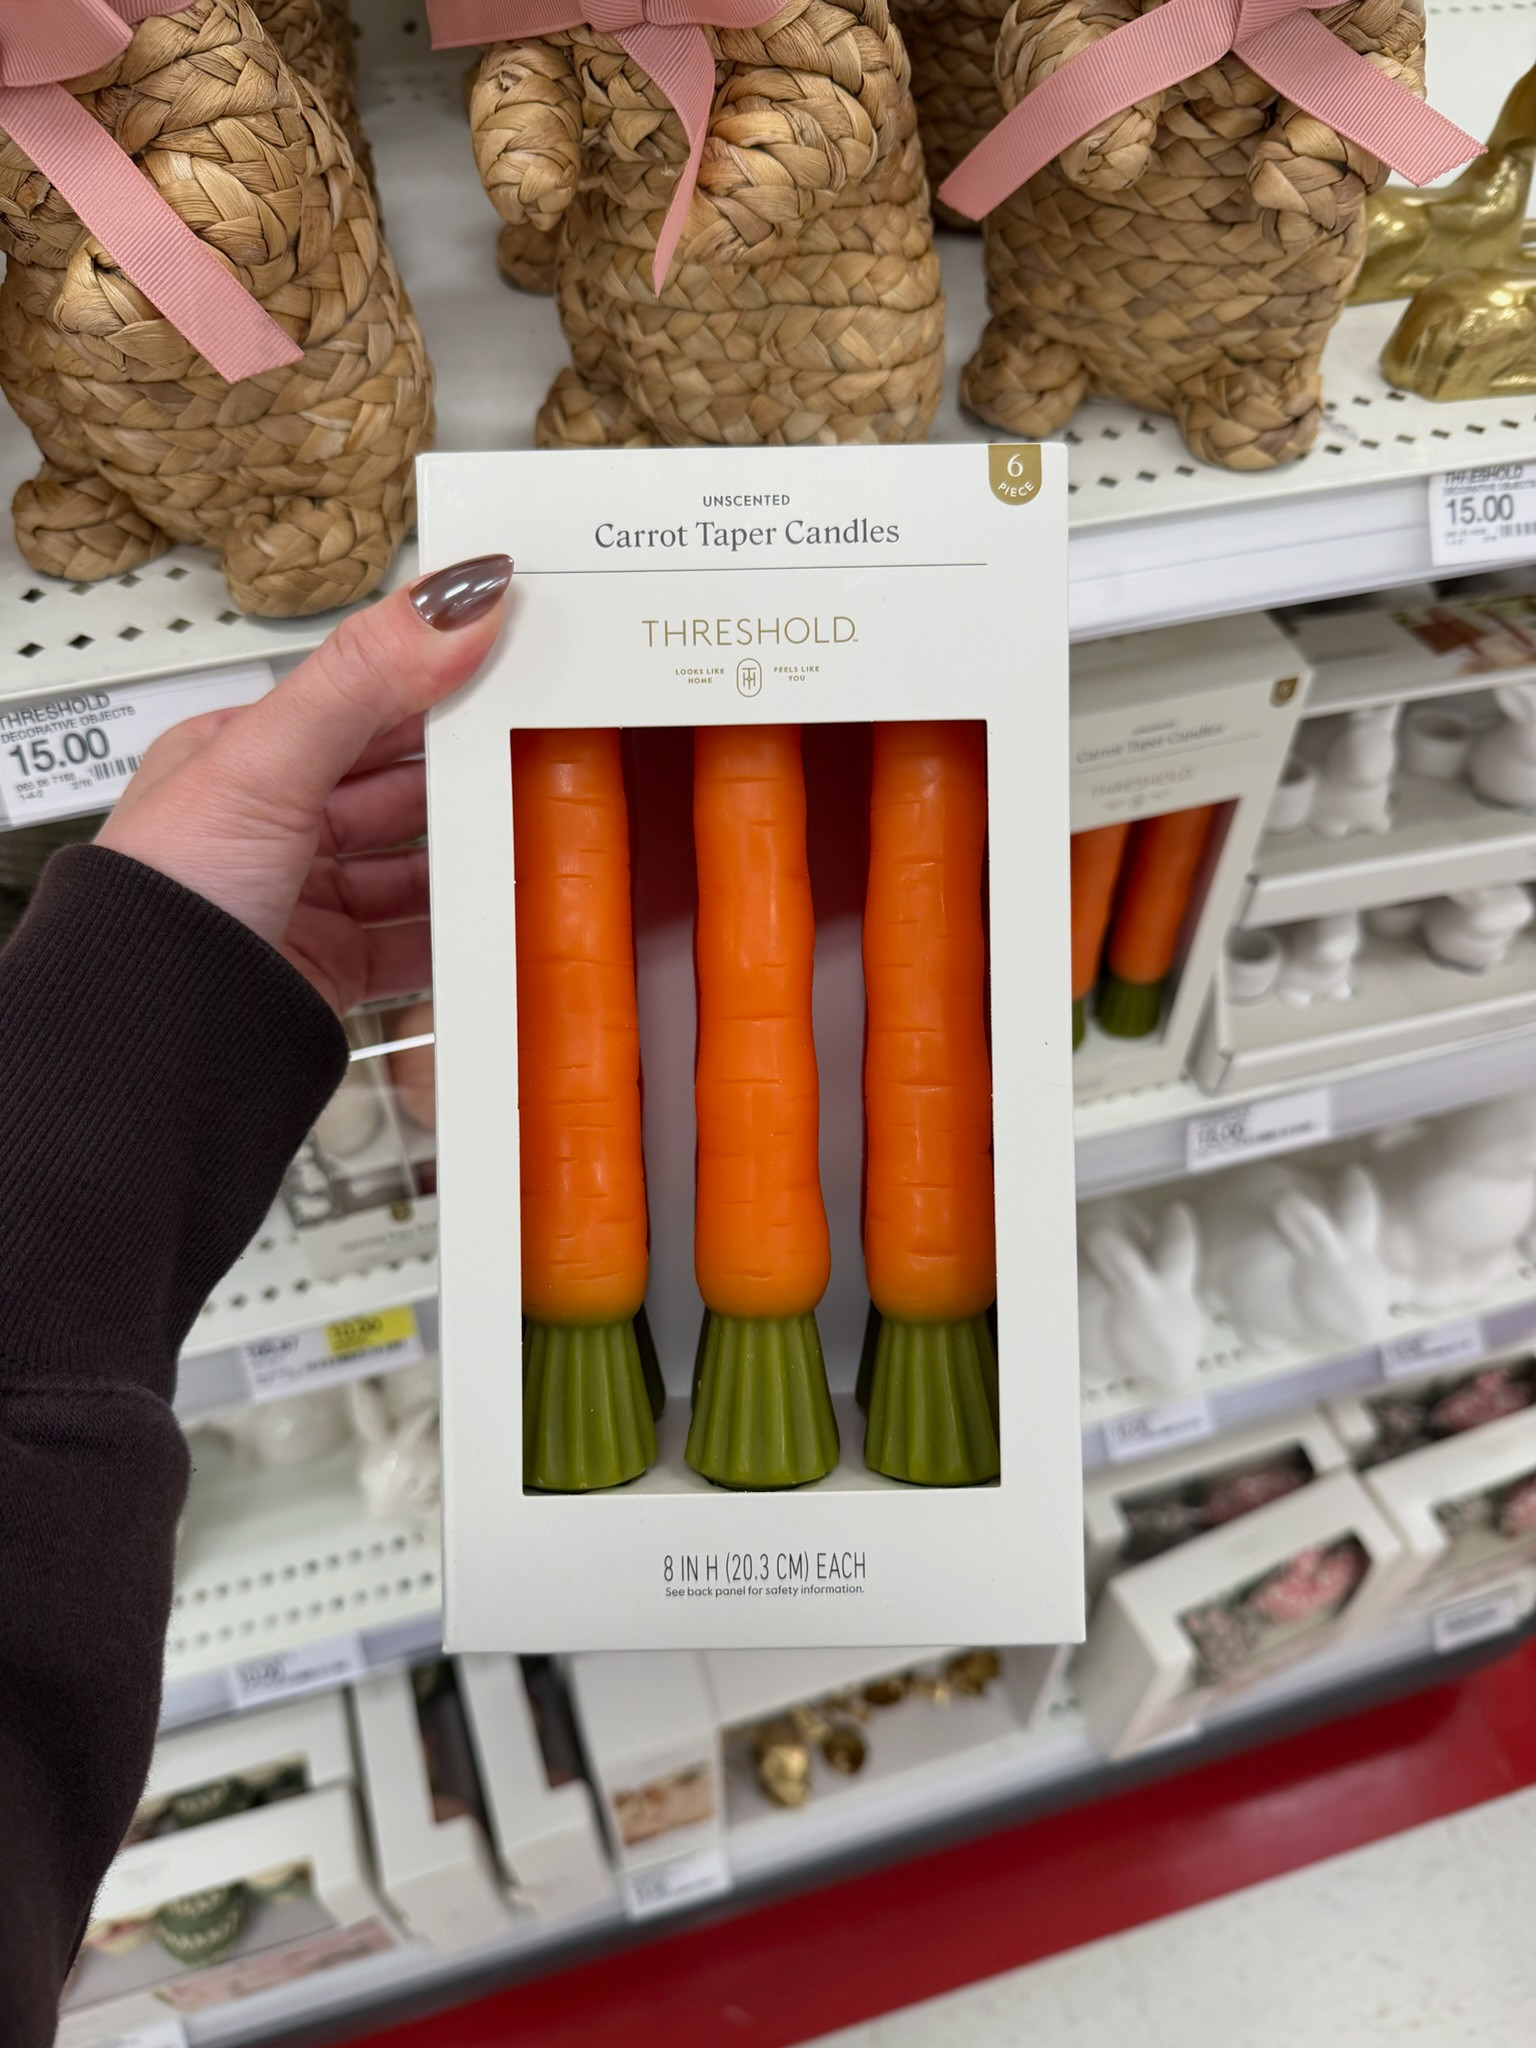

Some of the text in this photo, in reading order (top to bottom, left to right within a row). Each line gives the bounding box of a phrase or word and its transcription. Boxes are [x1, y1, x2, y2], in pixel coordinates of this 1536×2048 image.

[1007, 453, 1023, 478] 6
[702, 494, 791, 508] UNSCENTED
[997, 481, 1035, 498] PIECE
[1446, 493, 1514, 525] 15.00
[594, 518, 900, 552] Carrot Taper Candles
[642, 616, 857, 648] THRESHOLD
[675, 668, 703, 676] LOOKS
[773, 665, 820, 673] FEELS LIKE
[0, 693, 110, 731] THRESHOLD
[1, 705, 136, 744] DECORATIVE OBJECTS
[9, 726, 111, 777] 15.00
[663, 1551, 866, 1583] 8 IN H (20.3 CM) EACH
[665, 1584, 865, 1598] See back panel for safety information.
